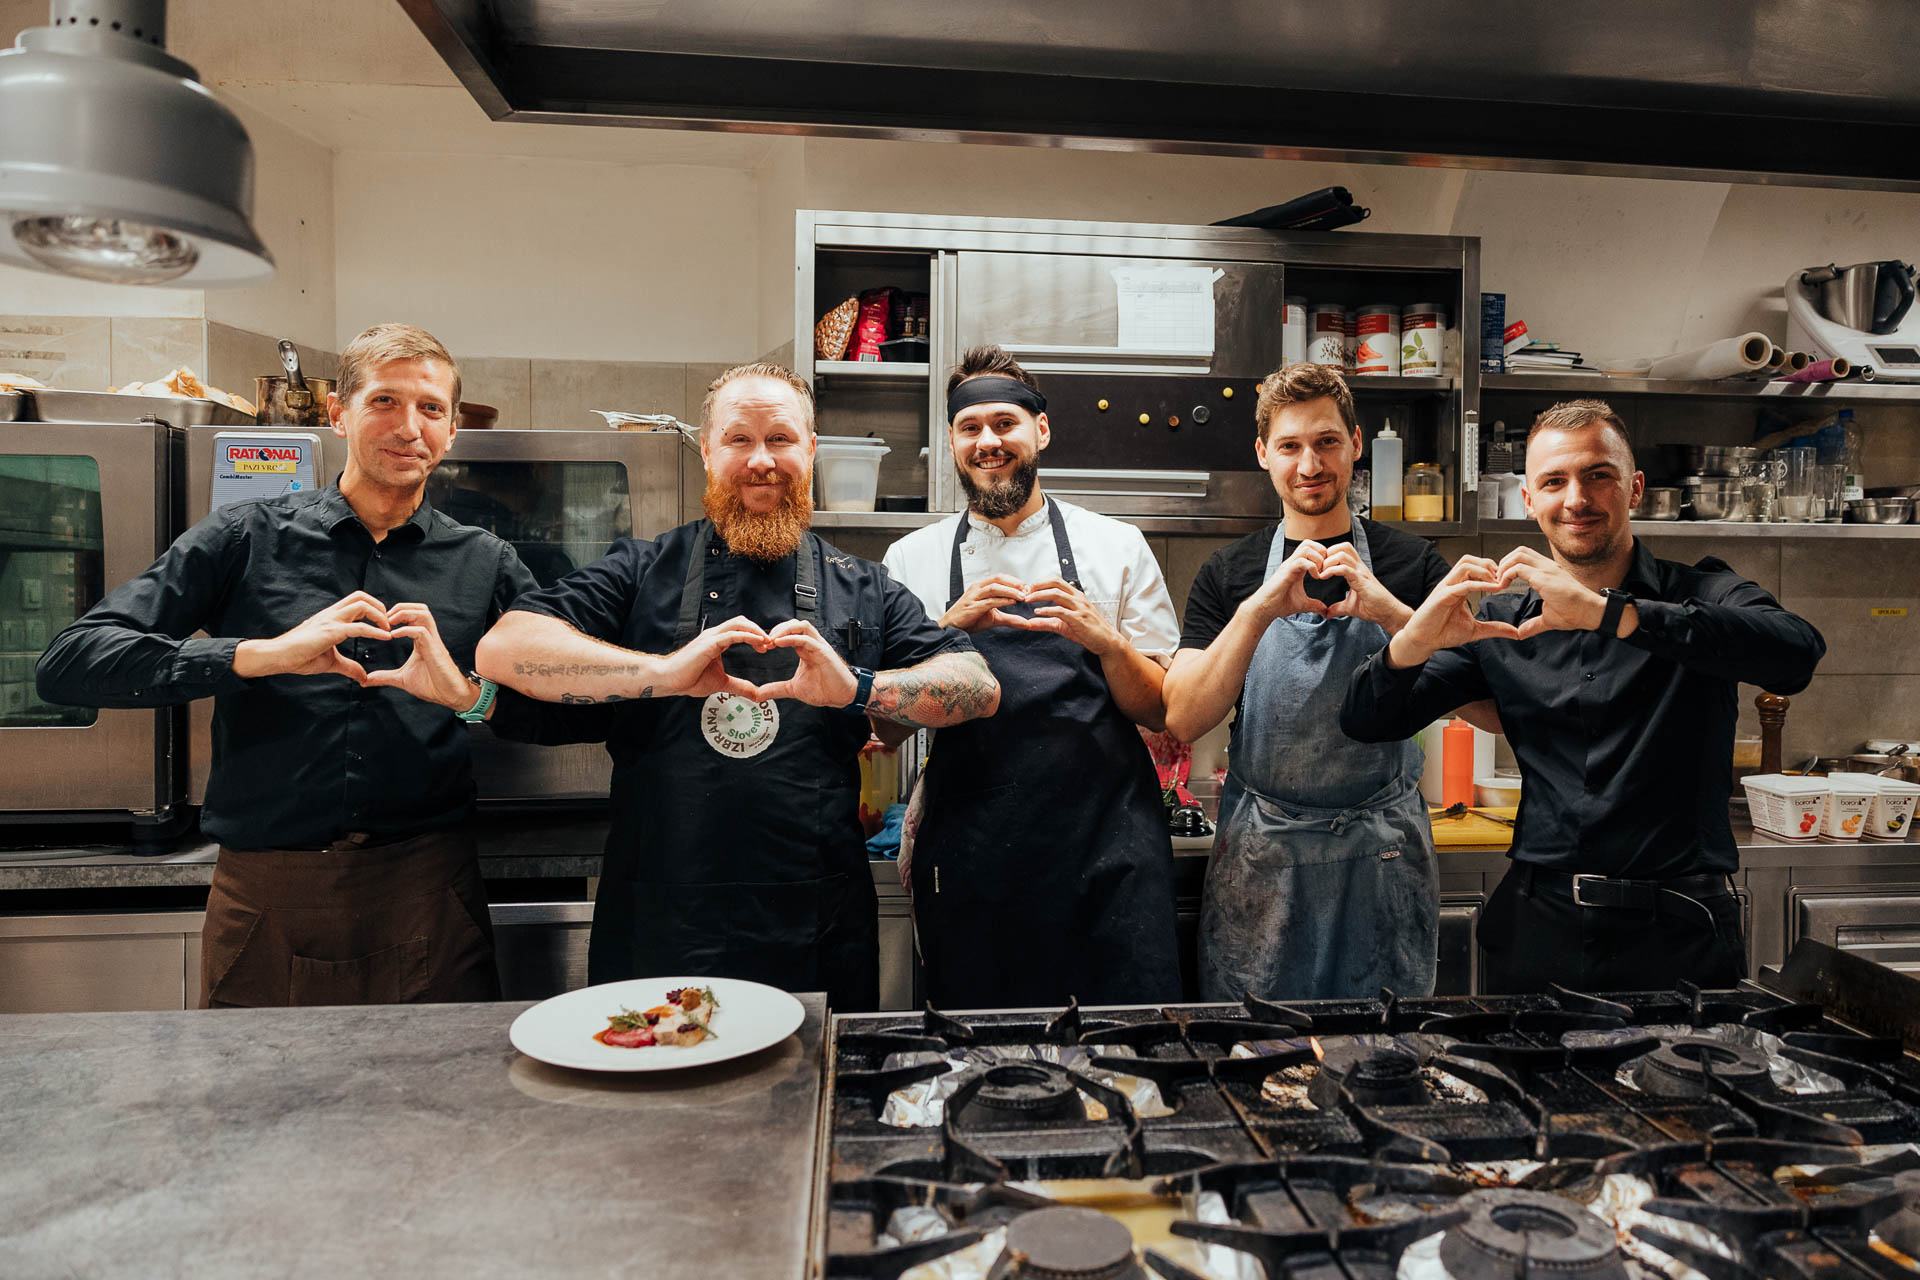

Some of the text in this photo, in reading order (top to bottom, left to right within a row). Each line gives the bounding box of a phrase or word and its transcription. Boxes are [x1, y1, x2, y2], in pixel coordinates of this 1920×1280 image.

[229, 447, 300, 461] RATIONAL
[243, 463, 260, 472] PAZI
[706, 707, 745, 753] IZBRANA
